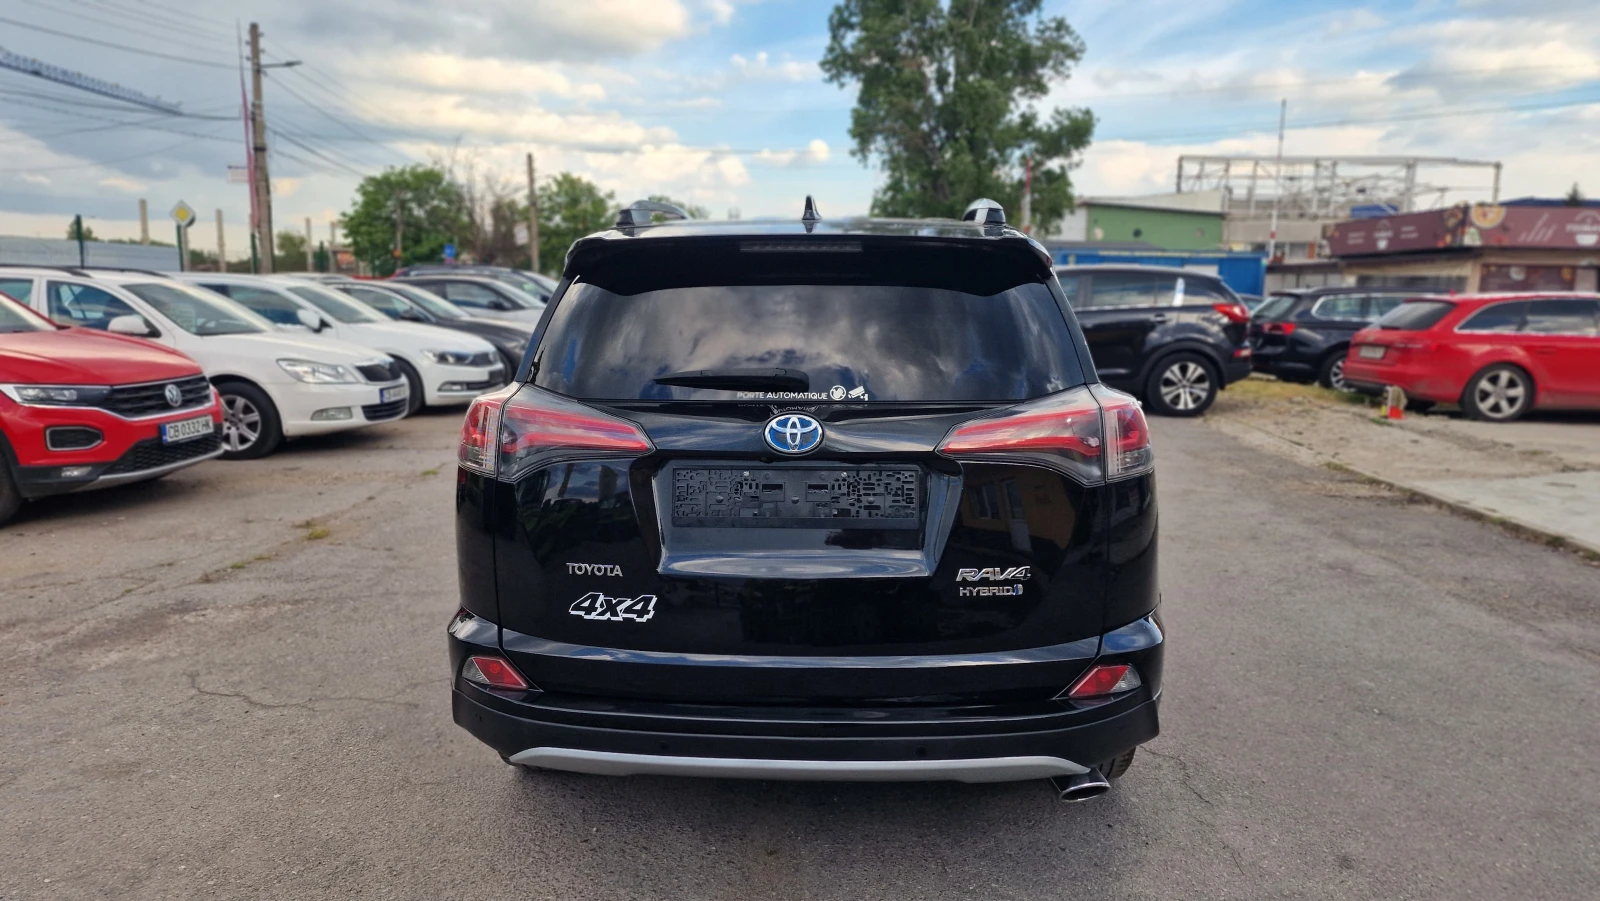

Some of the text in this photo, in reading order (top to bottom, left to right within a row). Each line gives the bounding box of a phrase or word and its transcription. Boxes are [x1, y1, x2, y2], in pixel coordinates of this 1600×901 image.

[736, 391, 828, 400] PORTE AUTOMATIQUE
[566, 562, 623, 577] TOYOTA
[956, 565, 1031, 582] RAV4
[959, 586, 1014, 597] HYBRID
